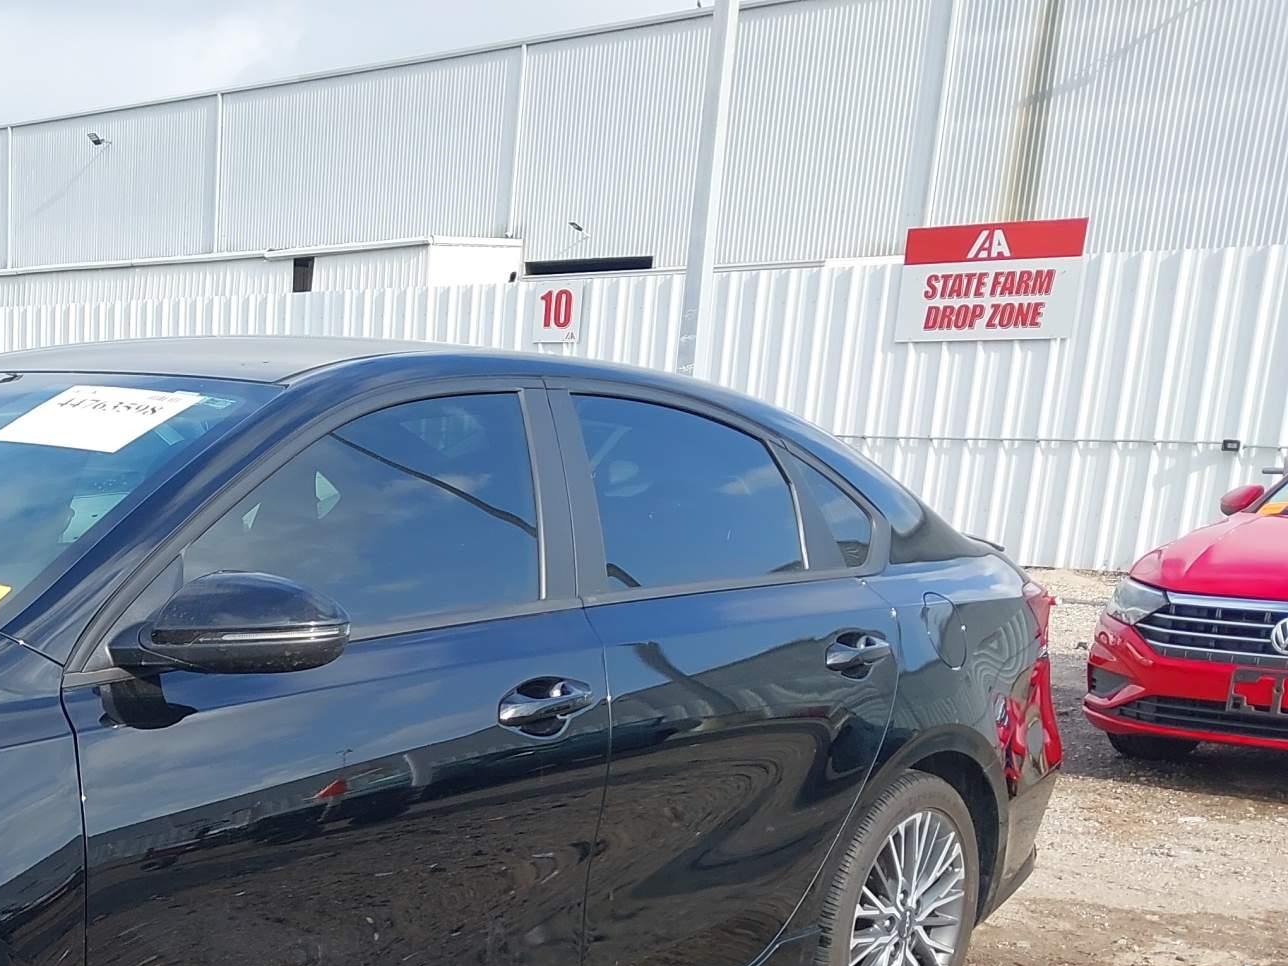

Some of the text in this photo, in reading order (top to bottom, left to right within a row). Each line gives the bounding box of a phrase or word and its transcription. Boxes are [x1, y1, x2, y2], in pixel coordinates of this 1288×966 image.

[924, 268, 1056, 300] STATE FARM
[540, 288, 573, 328] 10
[923, 302, 1045, 330] DROP ZONE
